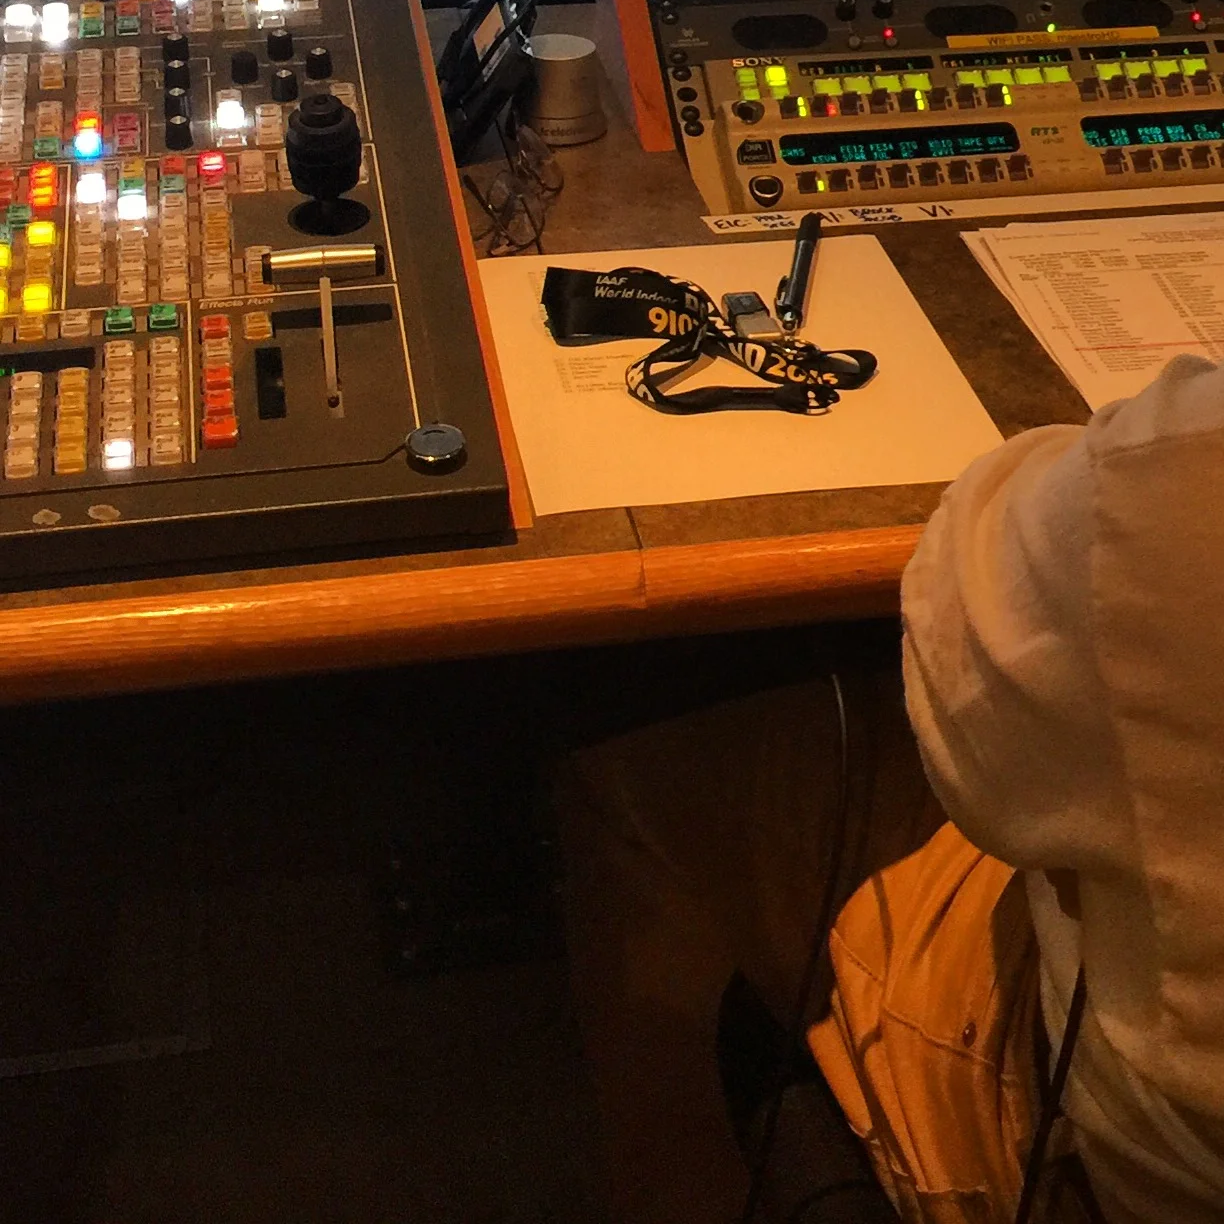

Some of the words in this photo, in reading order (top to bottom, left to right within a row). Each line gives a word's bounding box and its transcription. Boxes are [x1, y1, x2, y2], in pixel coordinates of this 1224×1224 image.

[732, 57, 787, 67] SONY
[595, 275, 628, 286] IAAF
[593, 286, 635, 300] World
